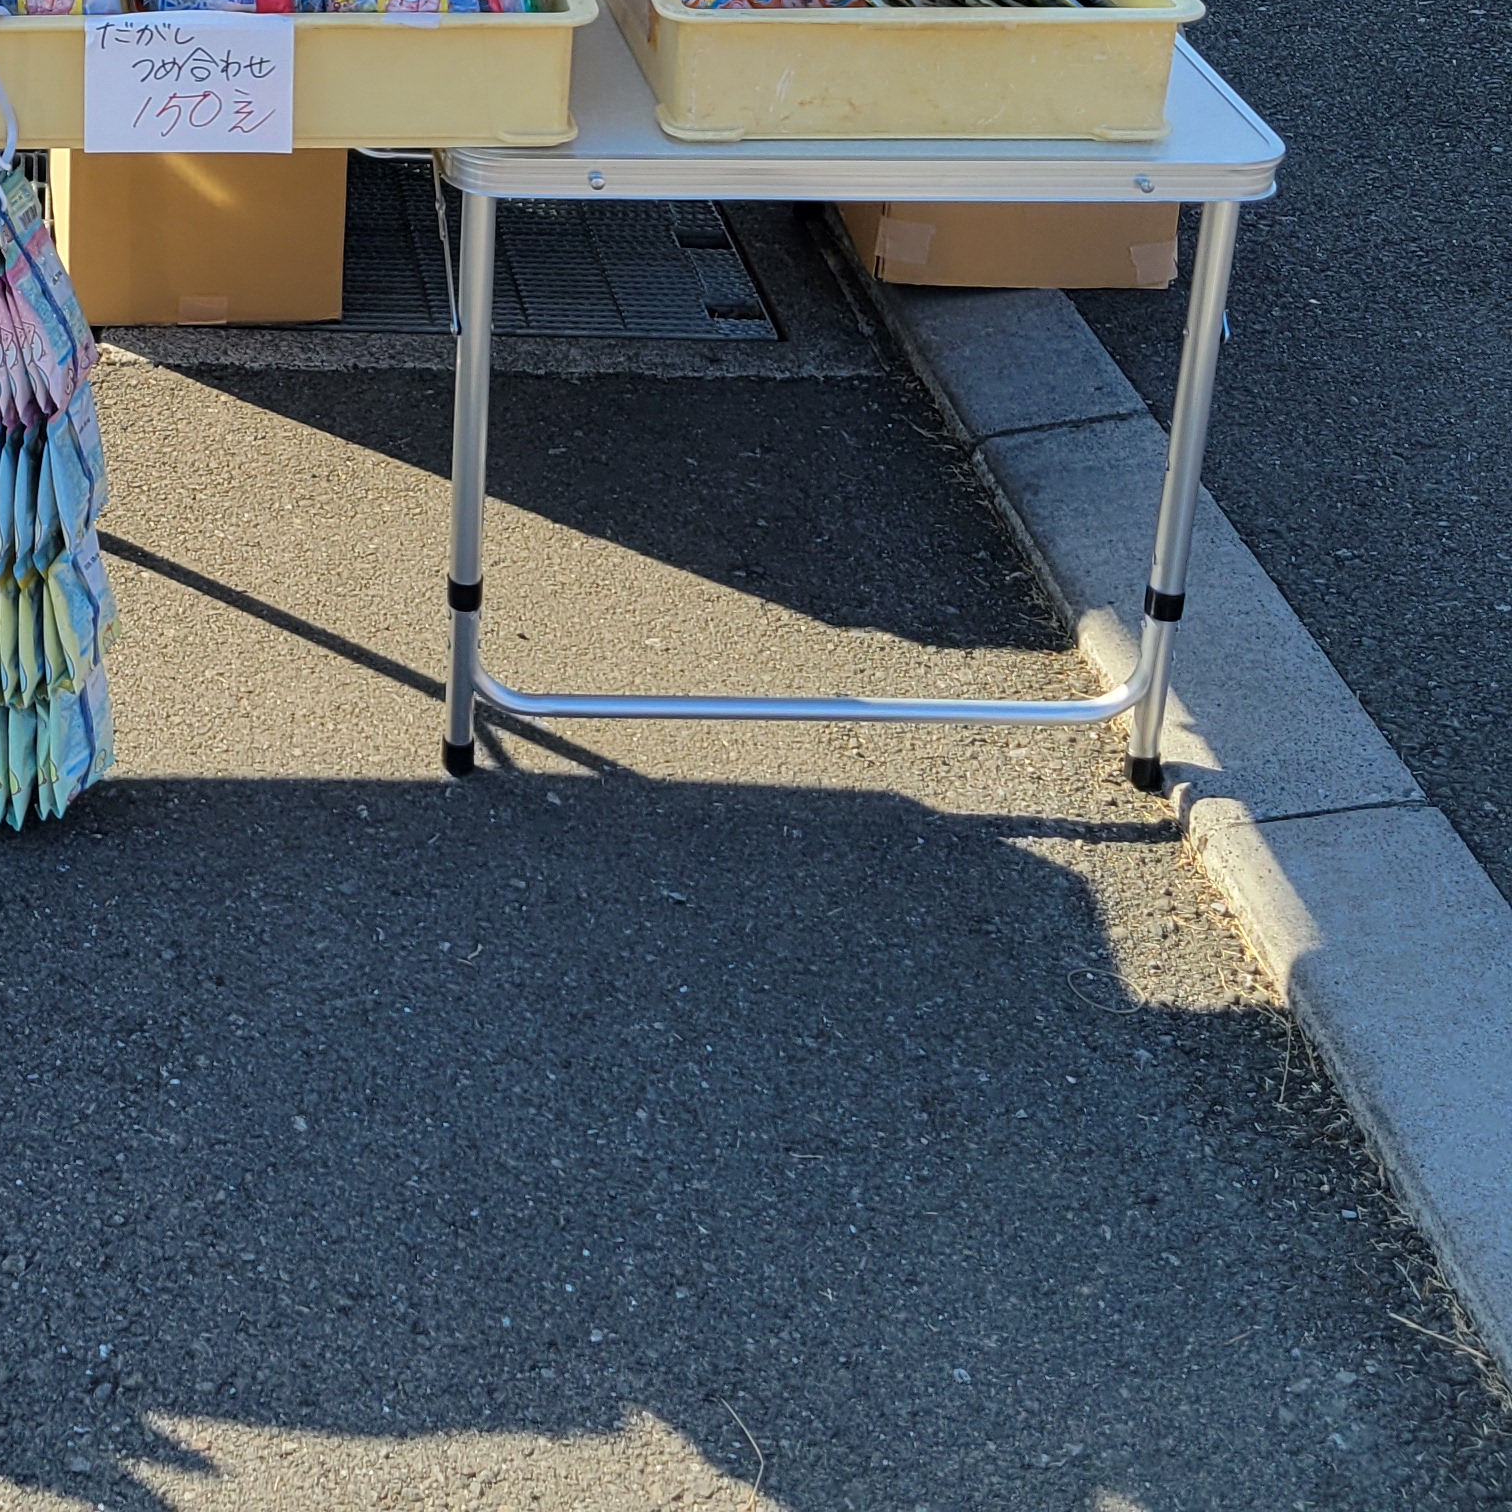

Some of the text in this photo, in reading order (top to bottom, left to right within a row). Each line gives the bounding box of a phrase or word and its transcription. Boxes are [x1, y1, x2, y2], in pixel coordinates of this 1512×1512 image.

[95, 21, 195, 49] だがし
[131, 46, 276, 83] つめ合わせ
